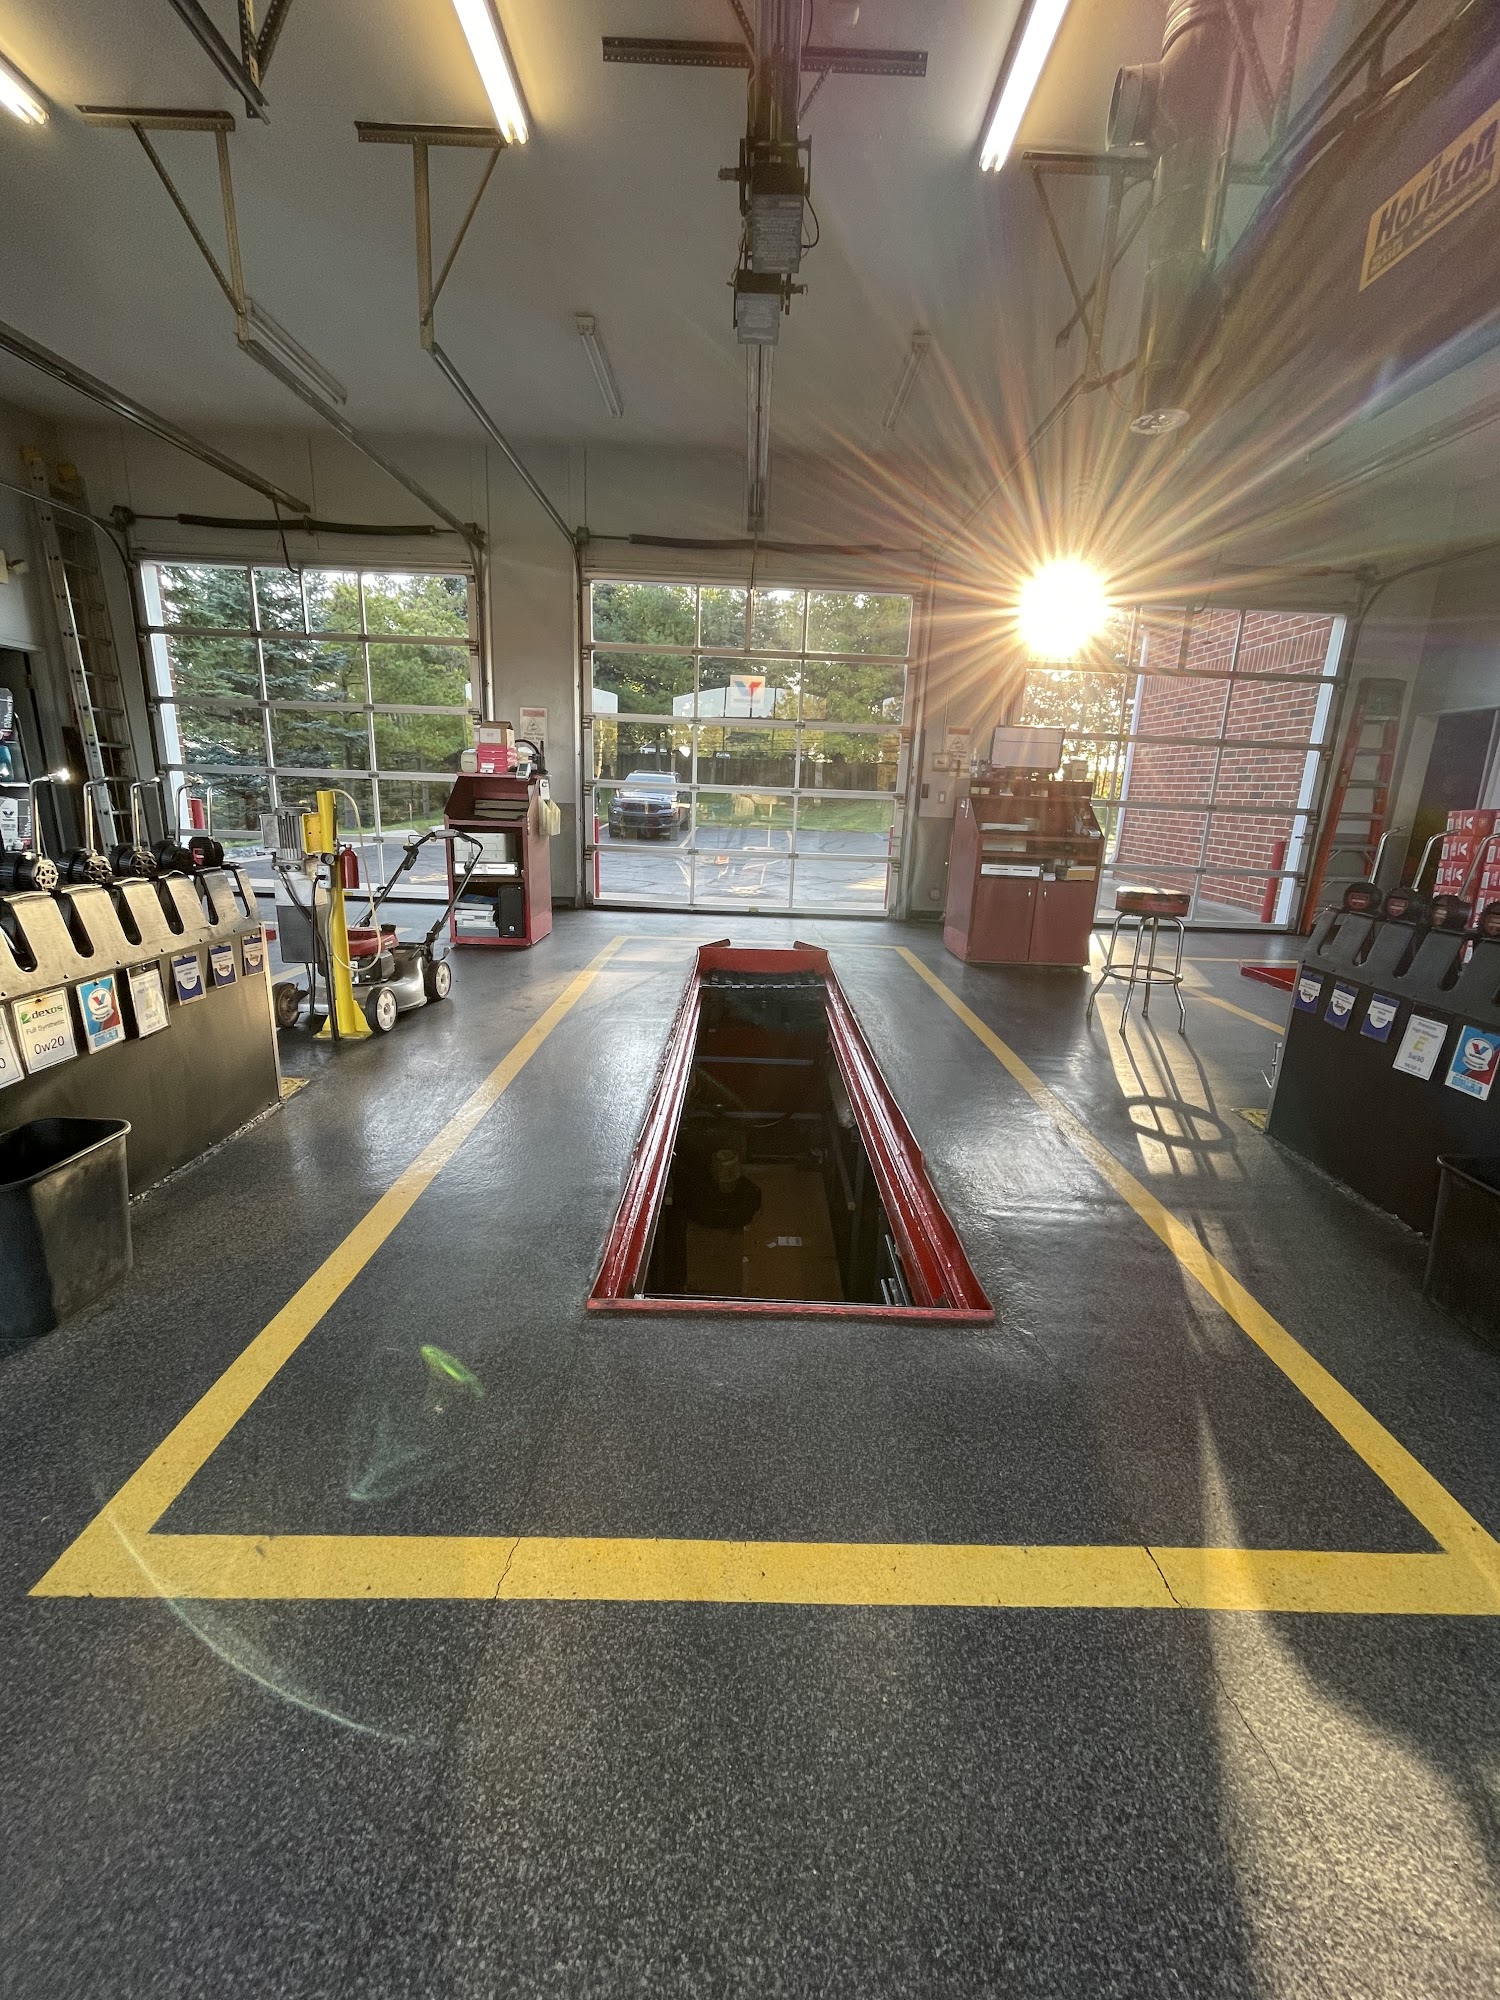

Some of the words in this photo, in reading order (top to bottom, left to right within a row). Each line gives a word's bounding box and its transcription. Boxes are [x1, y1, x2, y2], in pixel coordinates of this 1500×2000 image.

[1375, 119, 1499, 249] Horizon
[32, 1004, 63, 1020] dexos
[26, 1025, 37, 1035] Full
[38, 1019, 65, 1033] Synthetic
[34, 1035, 65, 1055] 0w20
